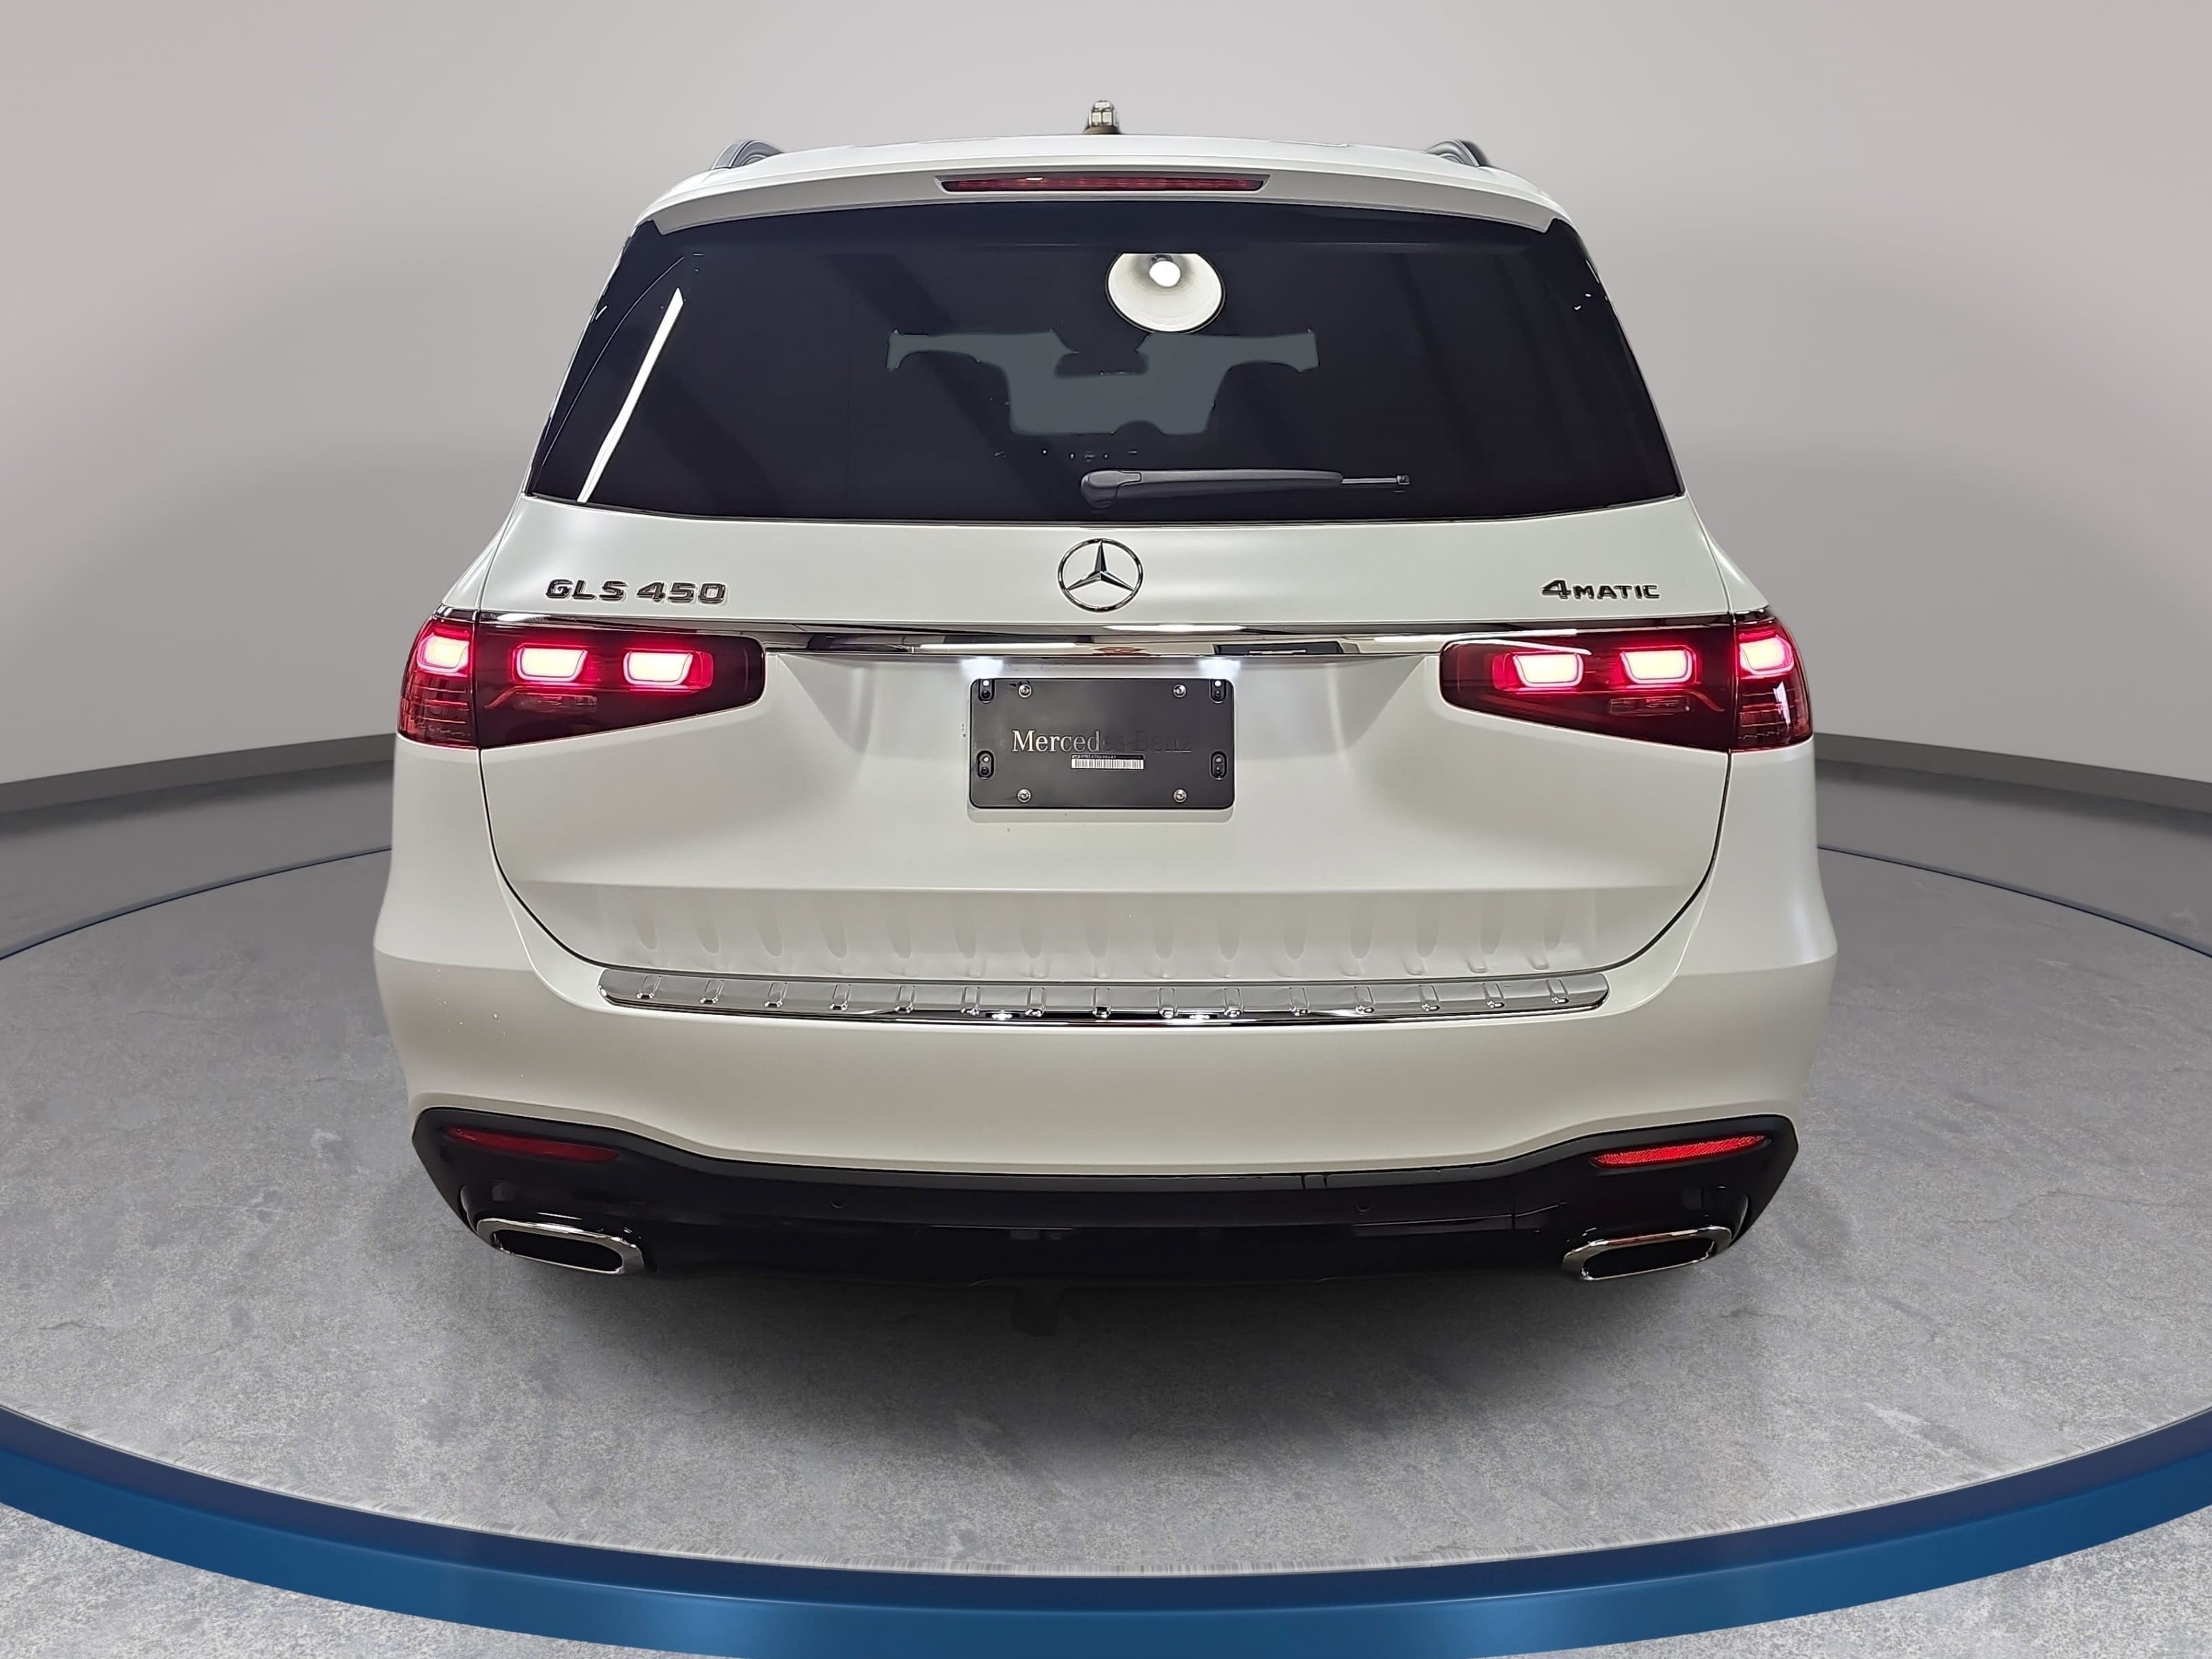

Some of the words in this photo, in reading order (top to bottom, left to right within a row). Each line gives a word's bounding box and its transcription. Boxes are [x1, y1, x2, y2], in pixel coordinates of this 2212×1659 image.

[545, 579, 628, 601] GLS
[636, 581, 726, 604] 450
[1541, 579, 1660, 599] 4MATIC
